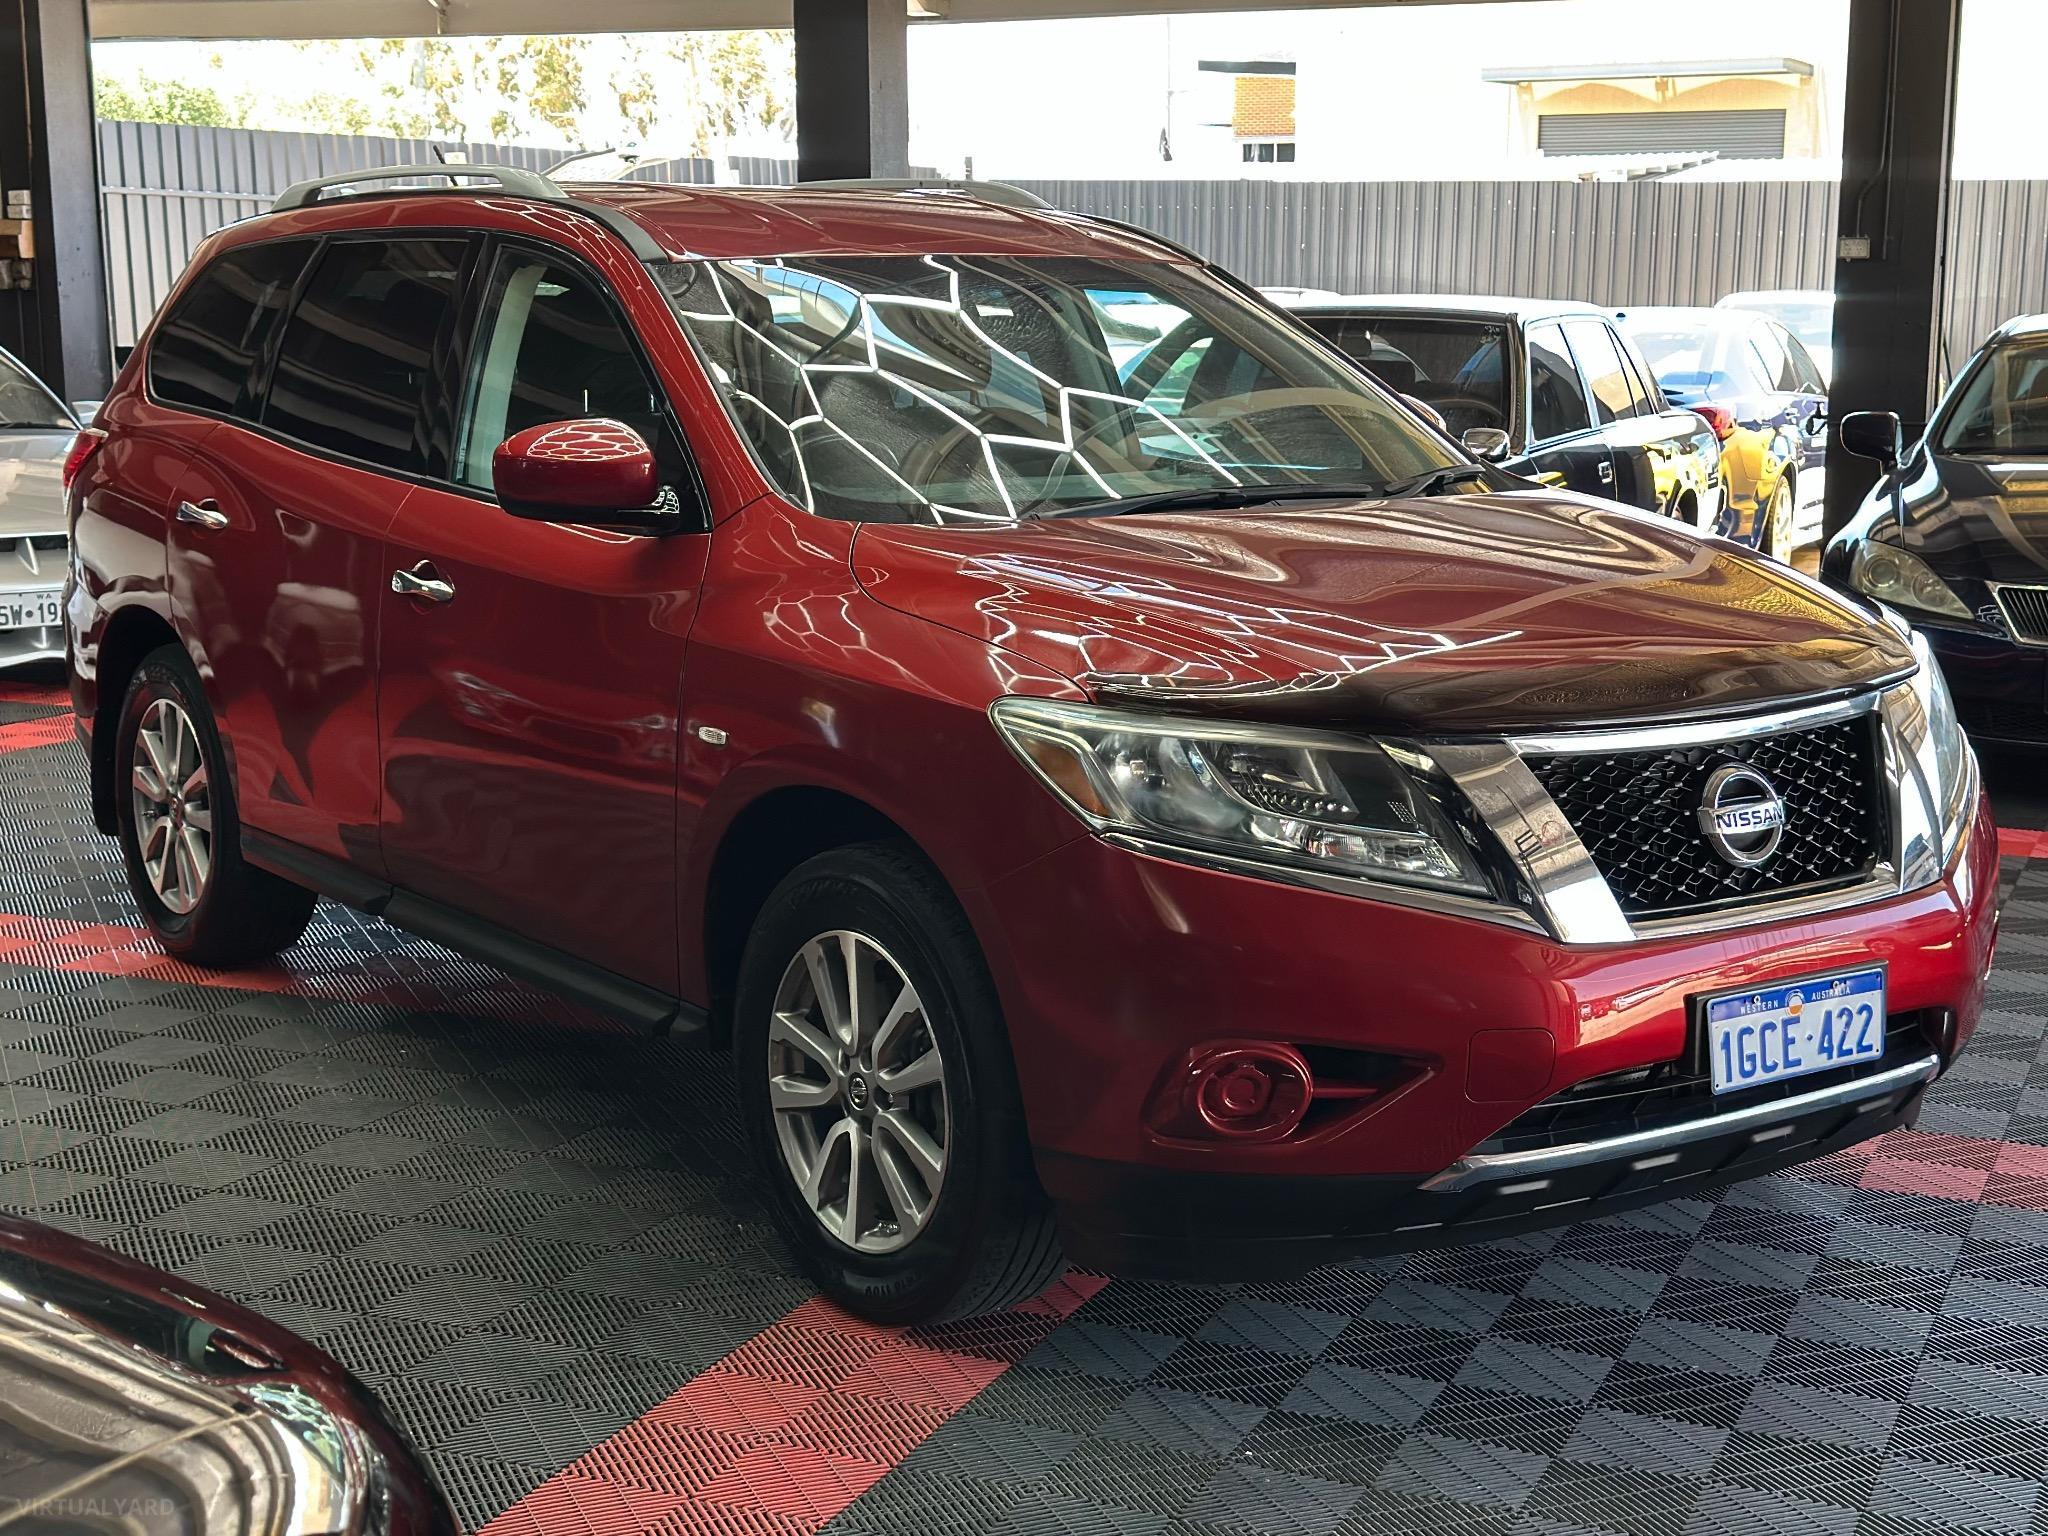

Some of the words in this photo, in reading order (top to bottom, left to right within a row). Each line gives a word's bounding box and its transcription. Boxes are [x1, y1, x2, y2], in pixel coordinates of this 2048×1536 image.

[1716, 807, 1784, 828] NISSAN
[1740, 999, 1779, 1015] WESTERN
[1811, 983, 1852, 1001] AUSTRALIA
